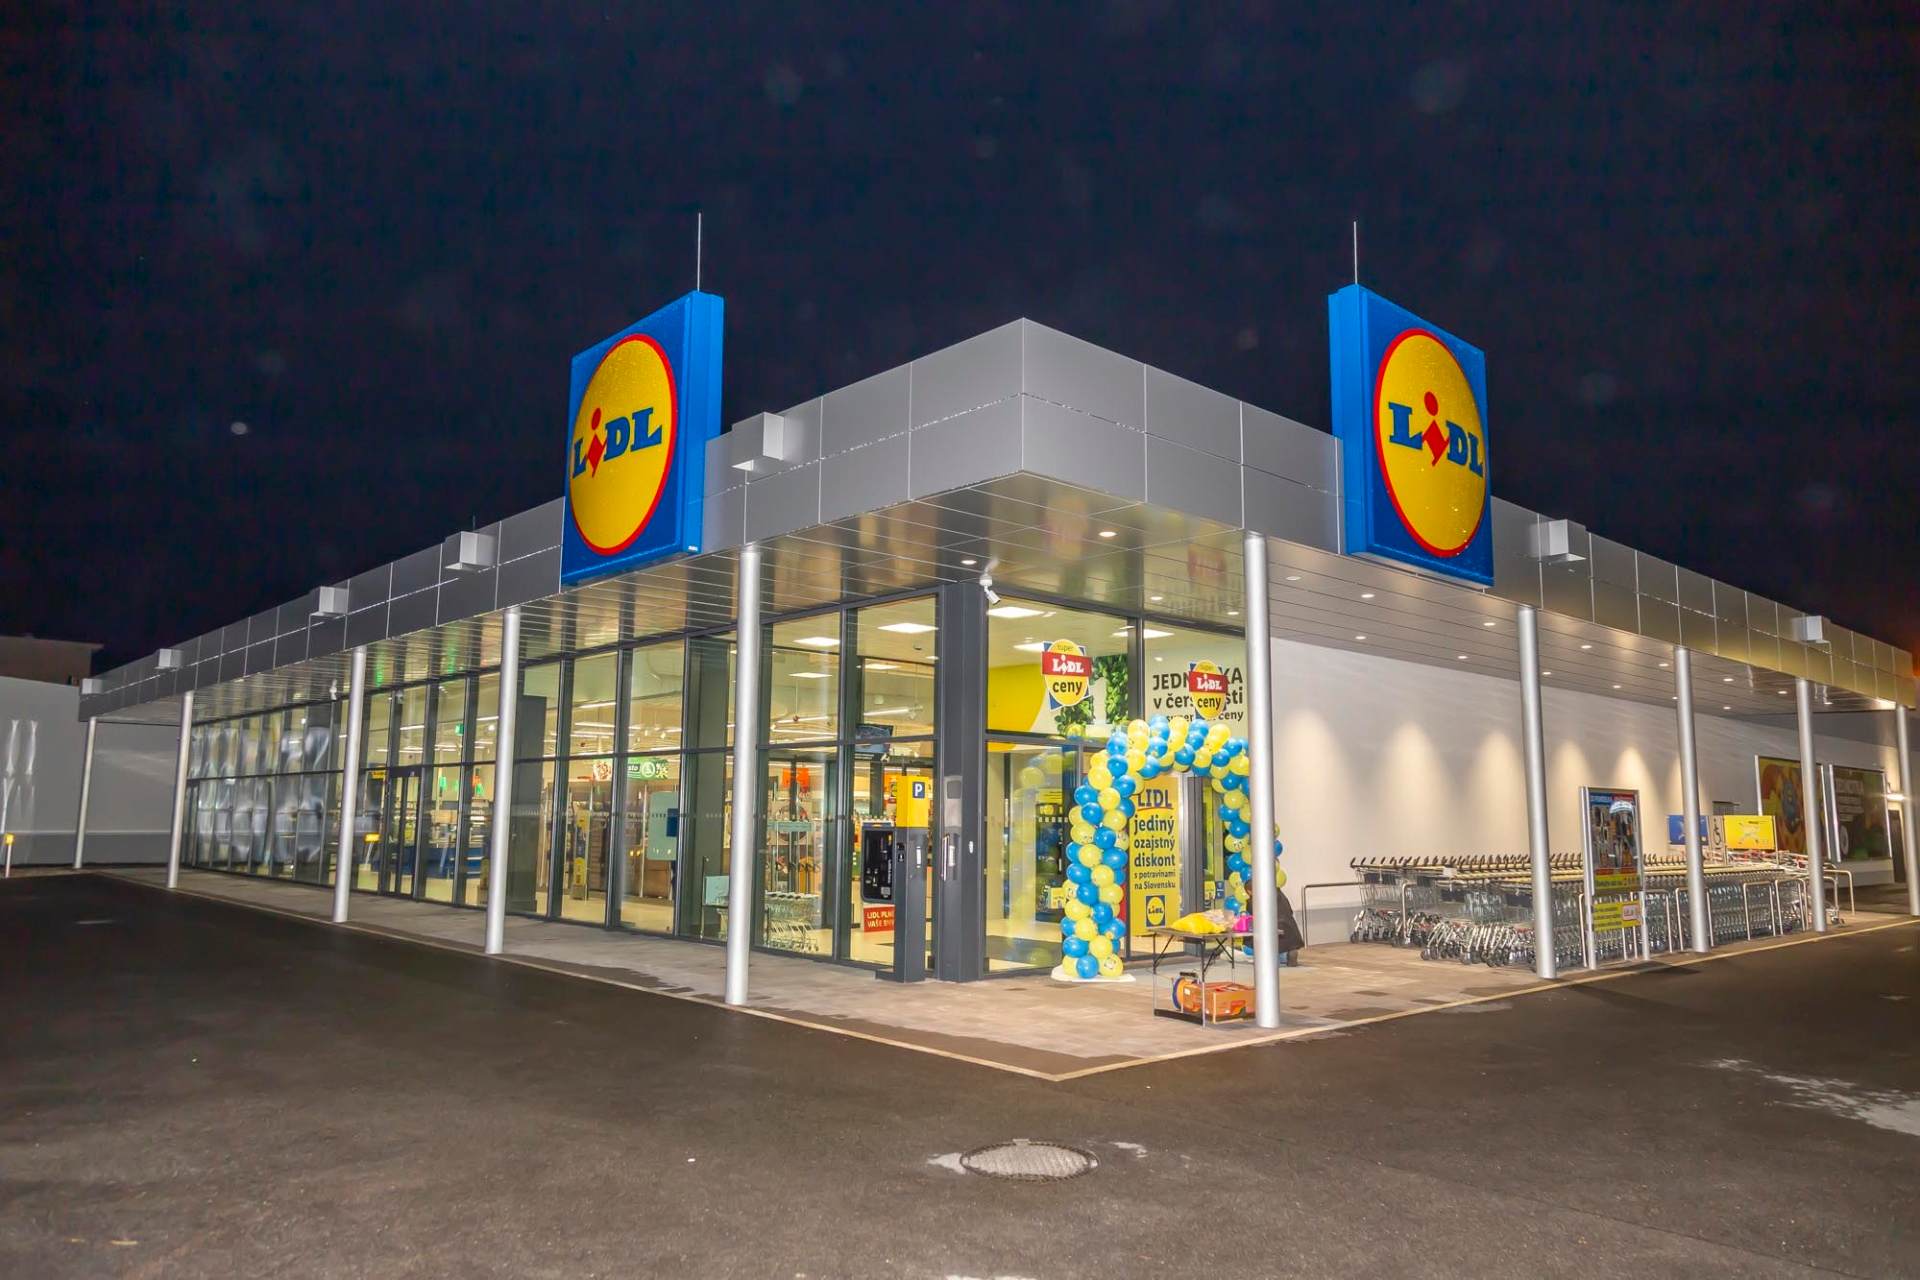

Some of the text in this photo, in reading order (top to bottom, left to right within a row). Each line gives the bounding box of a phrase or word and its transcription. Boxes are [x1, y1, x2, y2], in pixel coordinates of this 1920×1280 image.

[1052, 681, 1083, 696] ceny
[1153, 698, 1162, 709] v
[1197, 697, 1222, 710] ceny
[1218, 711, 1244, 722] ceny
[914, 783, 923, 797] P
[1138, 789, 1172, 808] LIDL
[1134, 814, 1175, 835] jediný
[1134, 835, 1176, 854] ozajstný
[1134, 852, 1176, 867] diskont
[1138, 869, 1176, 880] potravinami
[1144, 880, 1176, 889] Slovensku
